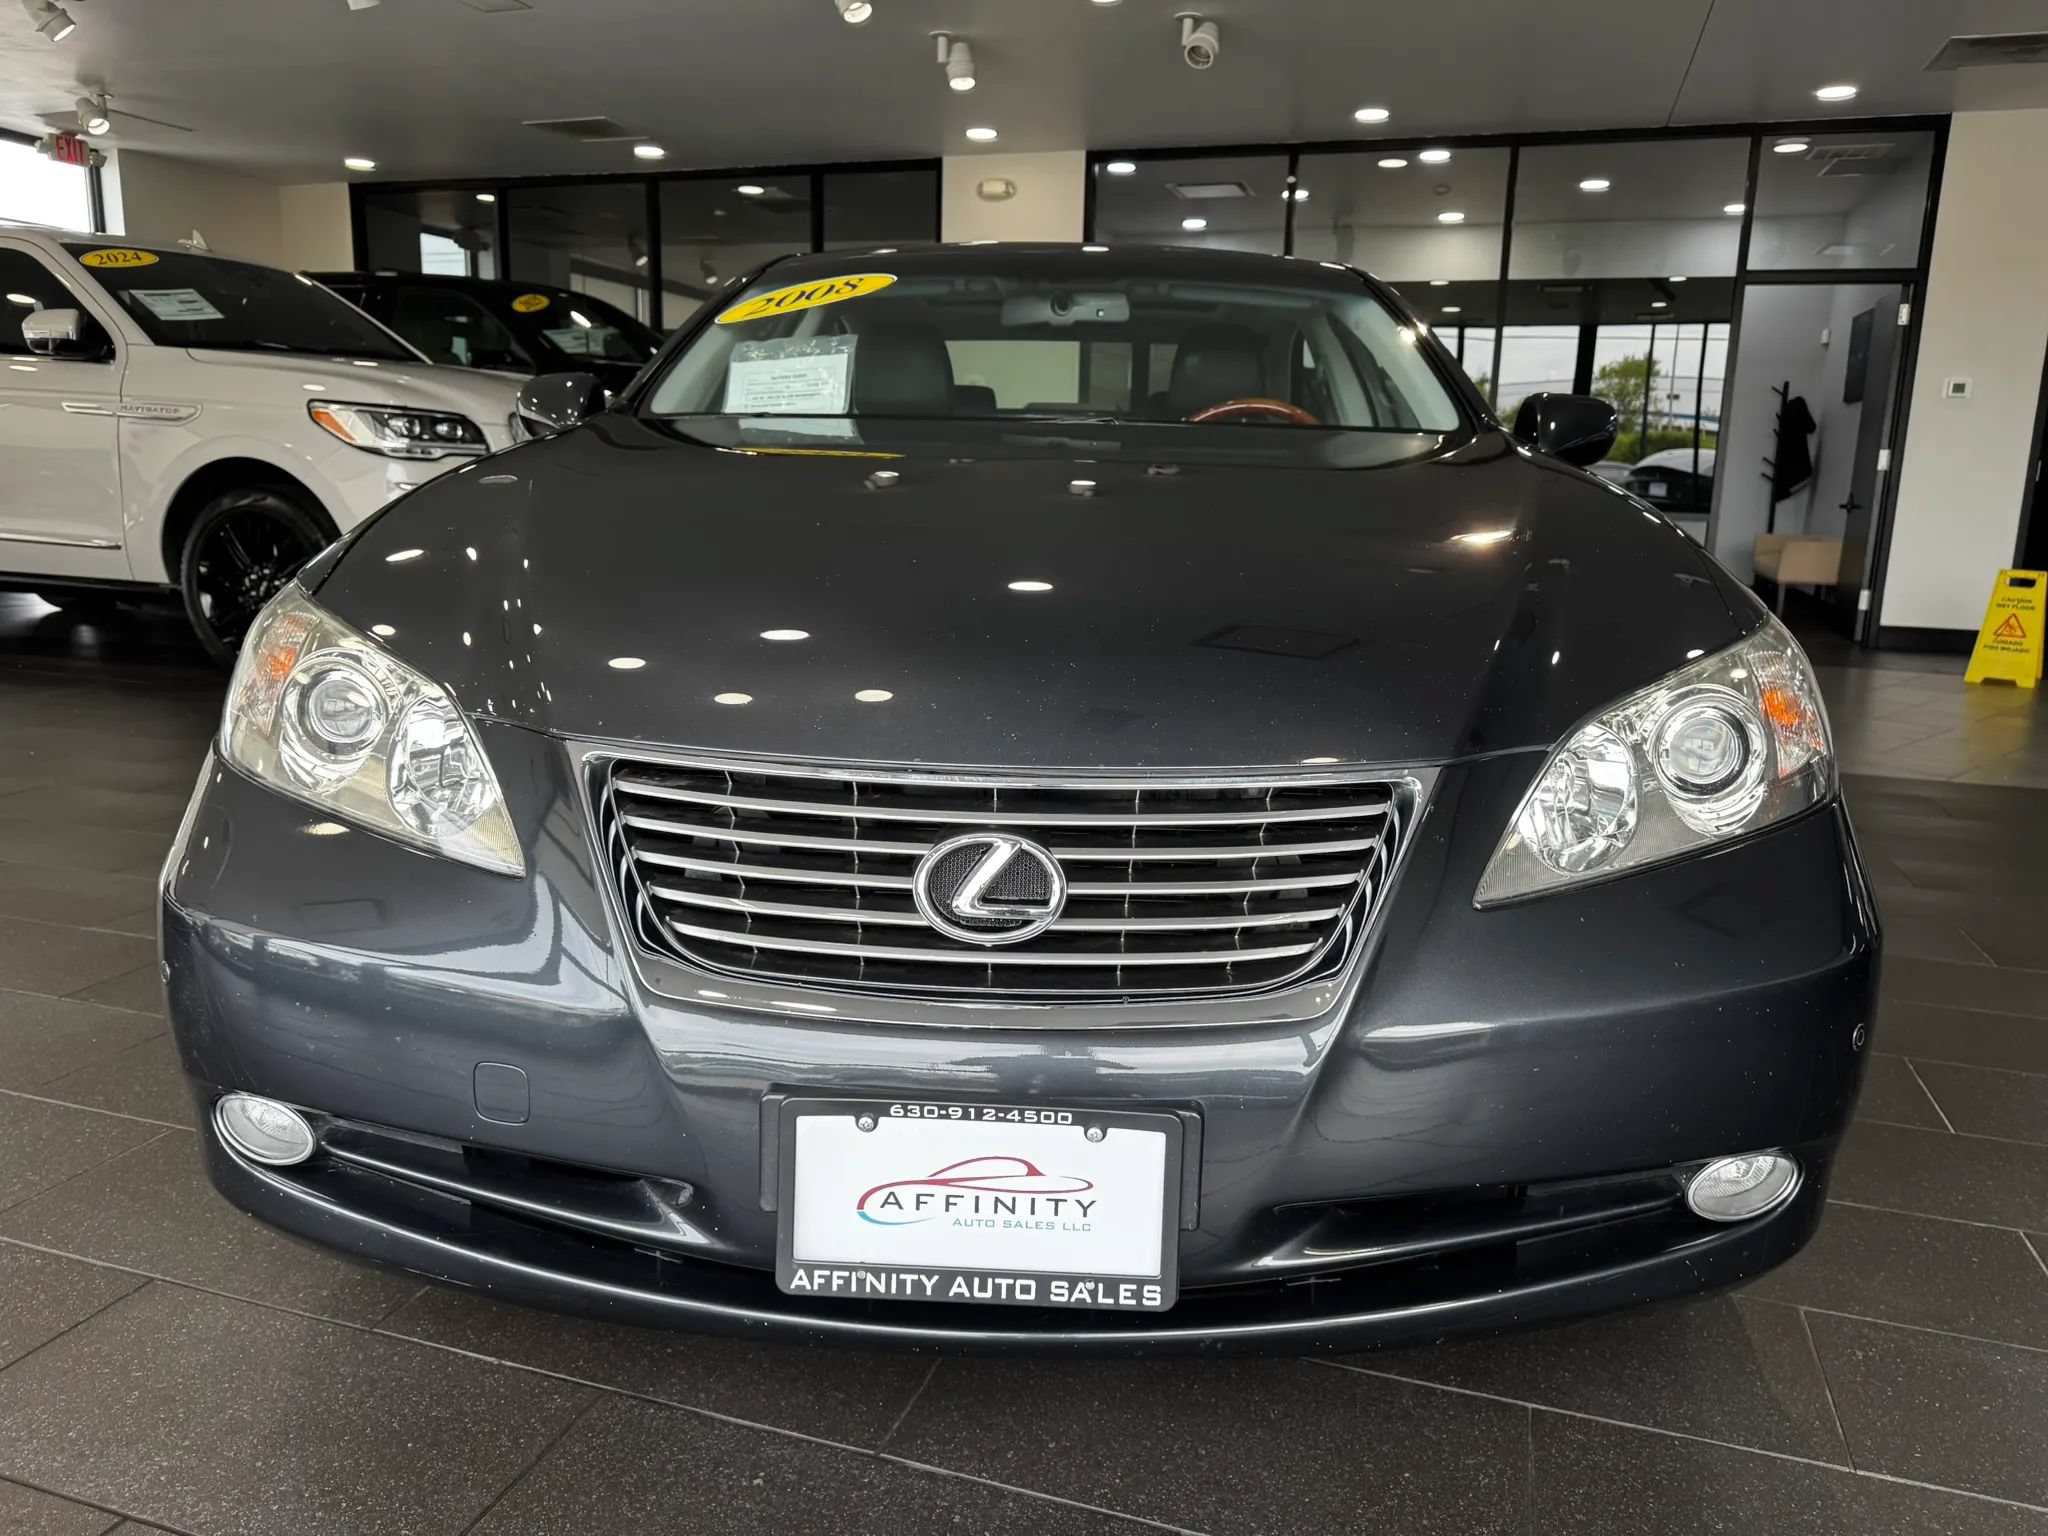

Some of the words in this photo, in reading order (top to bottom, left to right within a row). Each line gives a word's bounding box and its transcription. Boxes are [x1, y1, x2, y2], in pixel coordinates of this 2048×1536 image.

[56, 134, 85, 165] EXIT
[93, 251, 142, 265] 2024
[742, 277, 864, 319] 2008
[120, 405, 180, 415] NAVIGATOR
[889, 1104, 1073, 1125] 630-912-4500
[879, 1190, 1097, 1218] AFFINITY
[952, 1217, 995, 1228] AUTO
[1002, 1219, 1055, 1231] SALES
[1062, 1221, 1092, 1232] LLC
[789, 1268, 939, 1298] AFFINITY
[948, 1275, 1037, 1300] AUTO
[1050, 1280, 1162, 1306] SALES
